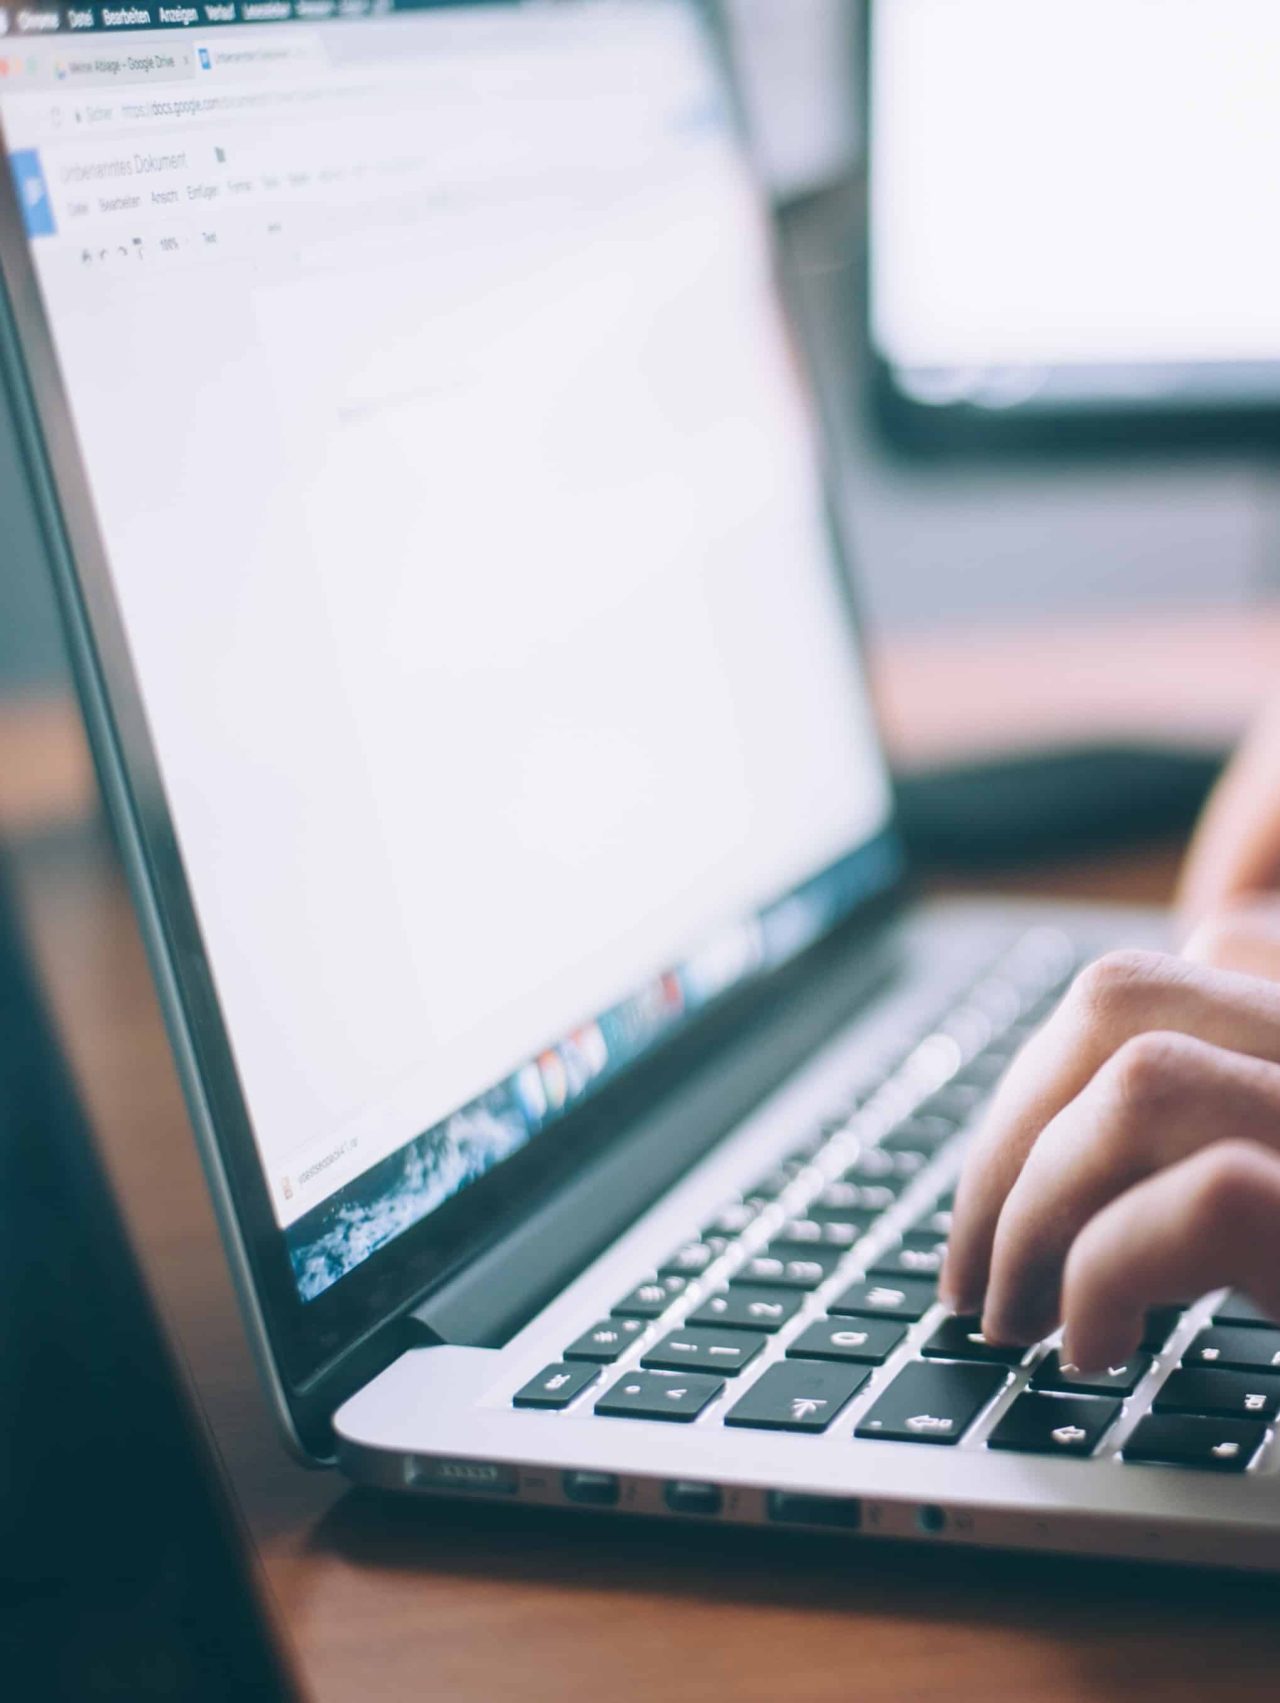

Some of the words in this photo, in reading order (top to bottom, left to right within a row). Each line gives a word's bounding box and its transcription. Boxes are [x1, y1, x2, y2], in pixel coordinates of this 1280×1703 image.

[101, 8, 151, 26] Bearbeiten
[158, 7, 199, 25] Anzeigen
[128, 57, 154, 74] Google
[155, 55, 175, 70] Drive
[134, 152, 188, 174] Dokument
[831, 1331, 869, 1347] Q
